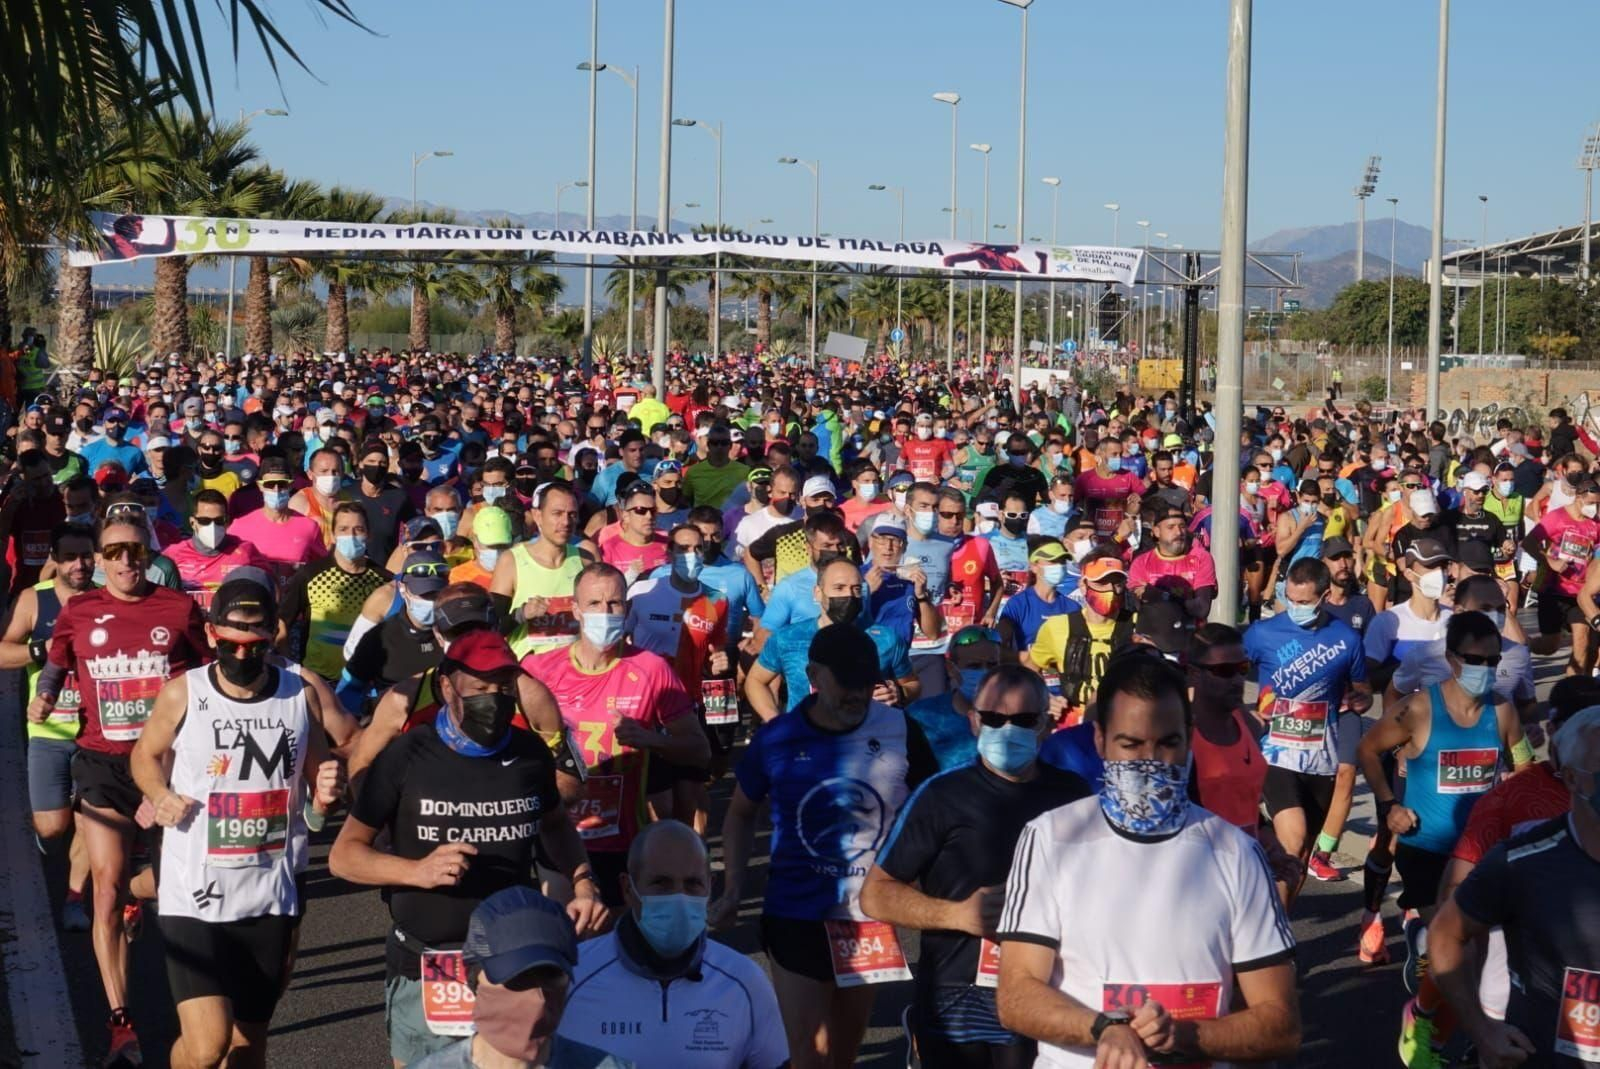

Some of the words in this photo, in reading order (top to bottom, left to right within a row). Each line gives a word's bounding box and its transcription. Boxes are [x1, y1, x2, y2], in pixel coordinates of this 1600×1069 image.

[304, 227, 386, 238] MEDIA
[396, 227, 523, 240] MARATON
[532, 229, 683, 247] CAIXABANK
[693, 232, 788, 245] CIUDAD
[798, 236, 830, 249] DE
[1281, 640, 1347, 695] MARATON
[1284, 643, 1328, 678] MEDIA
[105, 699, 146, 717] 2066
[212, 718, 286, 730] CASTILLA
[1278, 717, 1312, 732] 1339
[1447, 765, 1482, 779] 2116
[420, 797, 541, 817] DOMINGUEROS
[216, 818, 268, 838] 1969
[416, 825, 440, 841] DE
[837, 936, 884, 957] 3954
[601, 1022, 642, 1035] GOBIK
